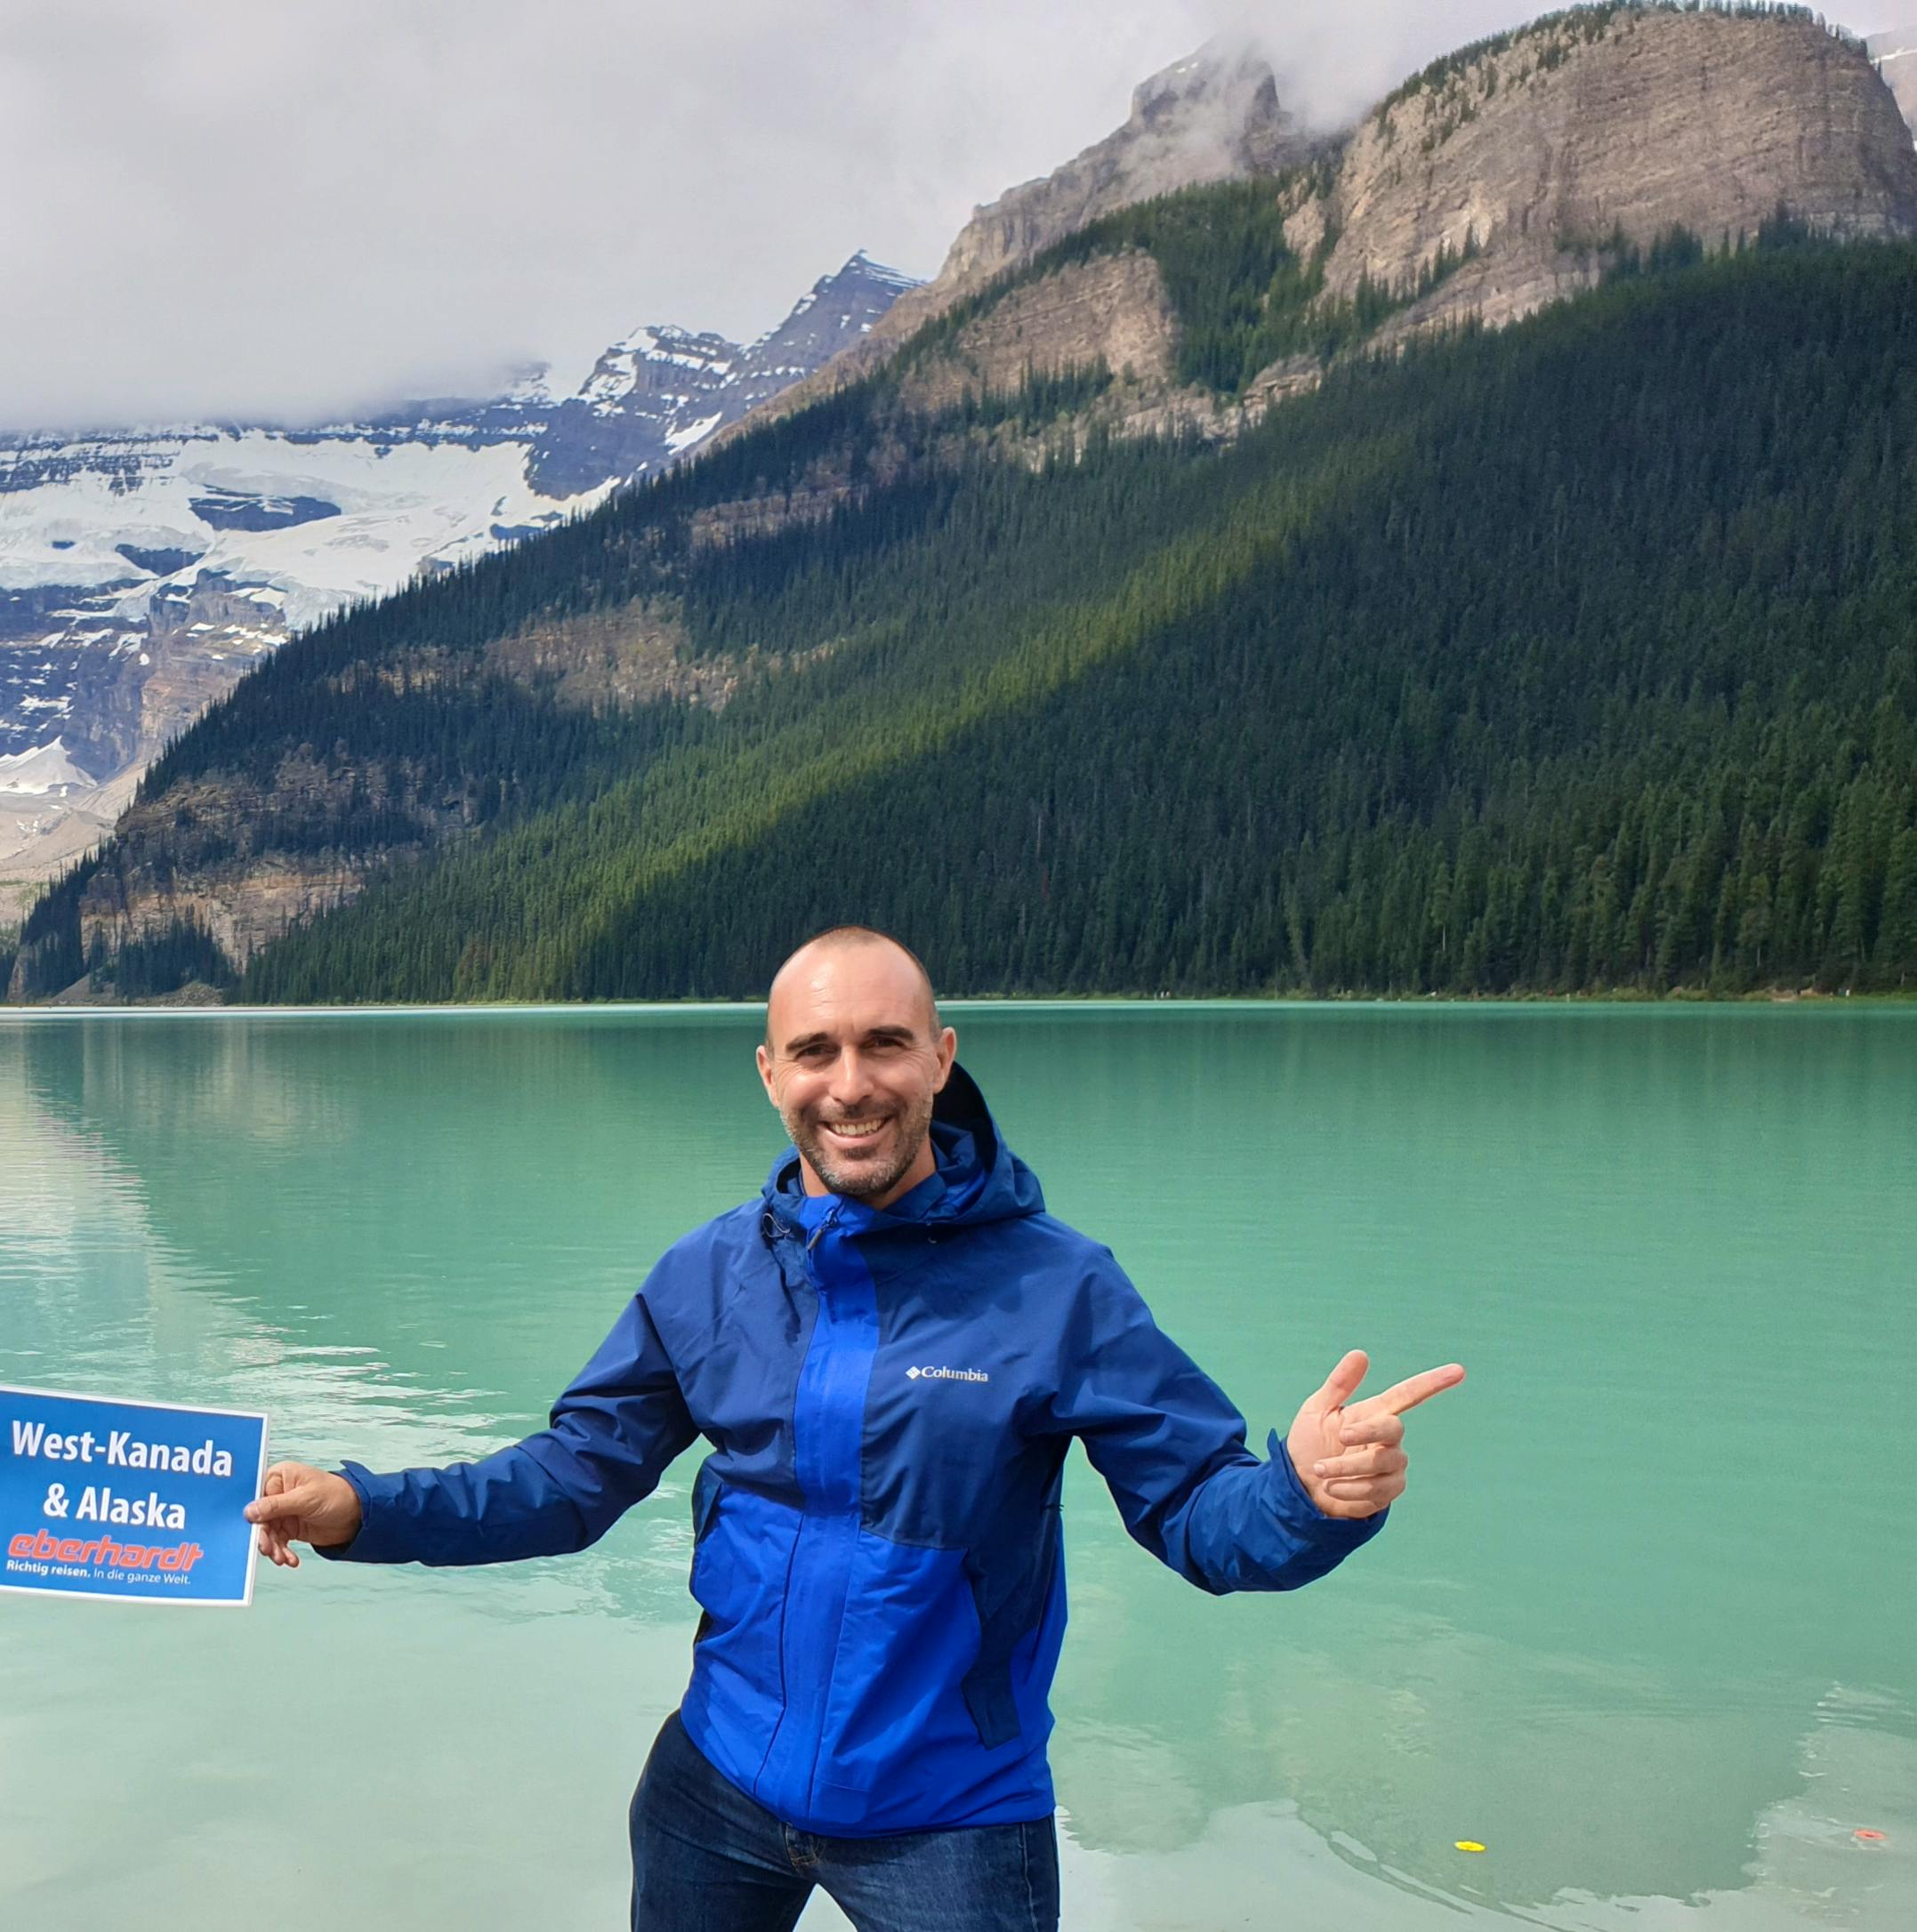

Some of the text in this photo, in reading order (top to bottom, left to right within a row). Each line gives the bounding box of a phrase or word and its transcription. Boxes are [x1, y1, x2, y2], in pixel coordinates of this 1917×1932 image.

[921, 1365, 988, 1381] Columbia
[12, 1421, 232, 1477] West-Kanada
[44, 1483, 186, 1529] & Alaska
[6, 1559, 191, 1584] Richtig reisen. In die ganze Welt.
[8, 1528, 204, 1572] eberhardt
